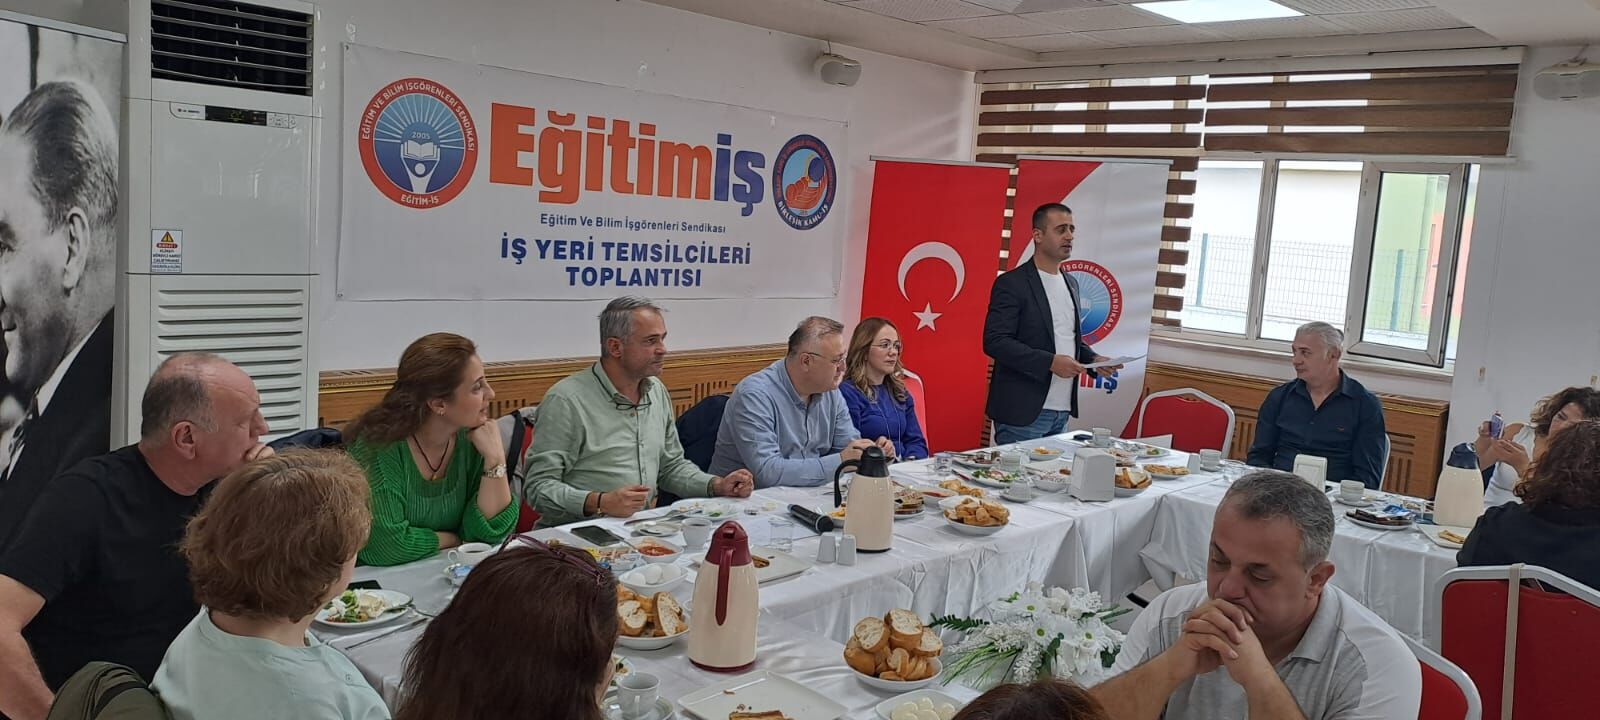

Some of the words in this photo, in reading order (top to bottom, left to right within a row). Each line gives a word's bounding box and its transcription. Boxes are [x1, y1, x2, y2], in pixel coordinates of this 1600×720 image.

[361, 110, 377, 140] EĞİTİM
[374, 97, 385, 109] VE
[383, 85, 404, 99] BİLİM
[455, 106, 475, 151] SENDİKASI
[411, 131, 431, 140] 2005
[540, 213, 577, 227] Eğitim
[579, 215, 593, 227] Ve
[595, 216, 623, 229] Bilim
[625, 215, 679, 232] İşgörenleri
[681, 221, 726, 233] Sendikası
[501, 232, 527, 265] İŞ
[535, 236, 594, 261] YERİ
[601, 239, 751, 265] TEMSİLCİLERİ
[566, 266, 702, 287] TOPLANTISI
